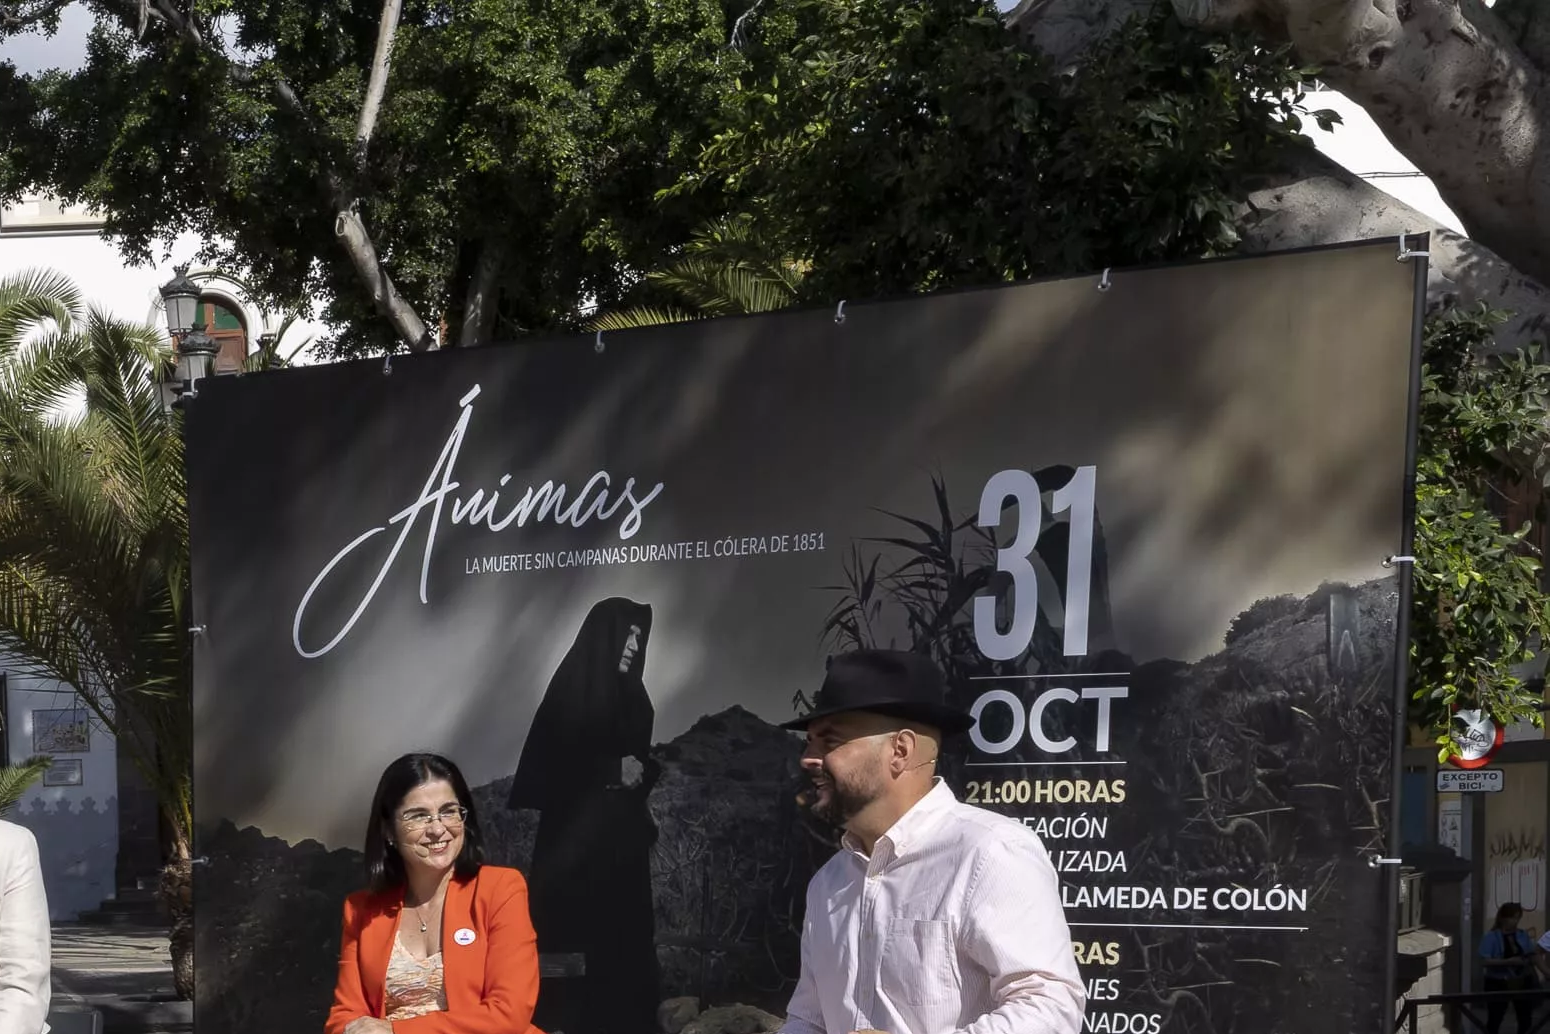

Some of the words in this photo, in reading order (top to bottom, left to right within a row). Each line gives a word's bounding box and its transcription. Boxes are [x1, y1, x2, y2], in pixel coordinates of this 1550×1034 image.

[292, 384, 665, 658] Ánimas
[465, 557, 481, 574] LA
[482, 554, 533, 573] MUERTE
[534, 552, 555, 569] SIN
[557, 546, 628, 568] CAMPANAS
[630, 541, 693, 564] DURANTE
[696, 541, 711, 558] EL
[713, 536, 767, 557] CÓLERA
[770, 535, 790, 553] DE
[793, 532, 826, 551] 1851
[974, 465, 1096, 661] 31
[968, 687, 1129, 754] OCT
[1442, 773, 1498, 781] EXCEPTO
[965, 780, 1031, 804] 21:00
[1034, 779, 1126, 804] HORAS
[1050, 850, 1127, 873] IZADA
[1062, 886, 1167, 910] LAMEDA
[1173, 887, 1208, 911] DE
[1212, 883, 1308, 912] COLÓN
[1071, 941, 1120, 965] RAS
[1084, 978, 1120, 1001] NES
